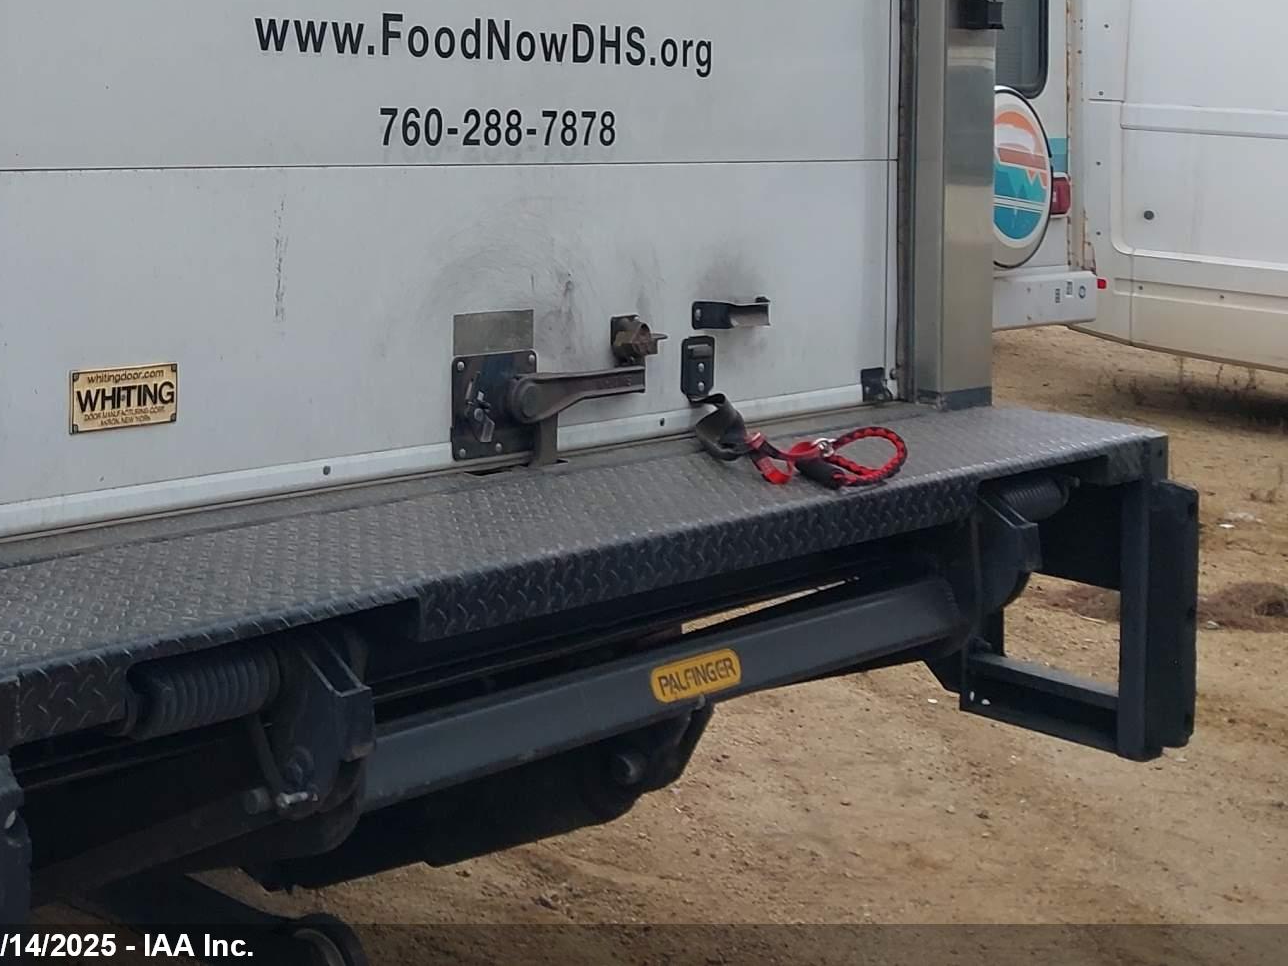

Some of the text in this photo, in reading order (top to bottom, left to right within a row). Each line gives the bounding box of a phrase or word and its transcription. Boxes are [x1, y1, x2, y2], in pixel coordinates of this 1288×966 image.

[255, 12, 713, 76] www.FoodNowDHS.org
[379, 108, 617, 146] 760-288-7878
[87, 370, 164, 383] whitingdoor.com
[76, 381, 175, 413] WHITING
[657, 657, 737, 696] PALFINGER
